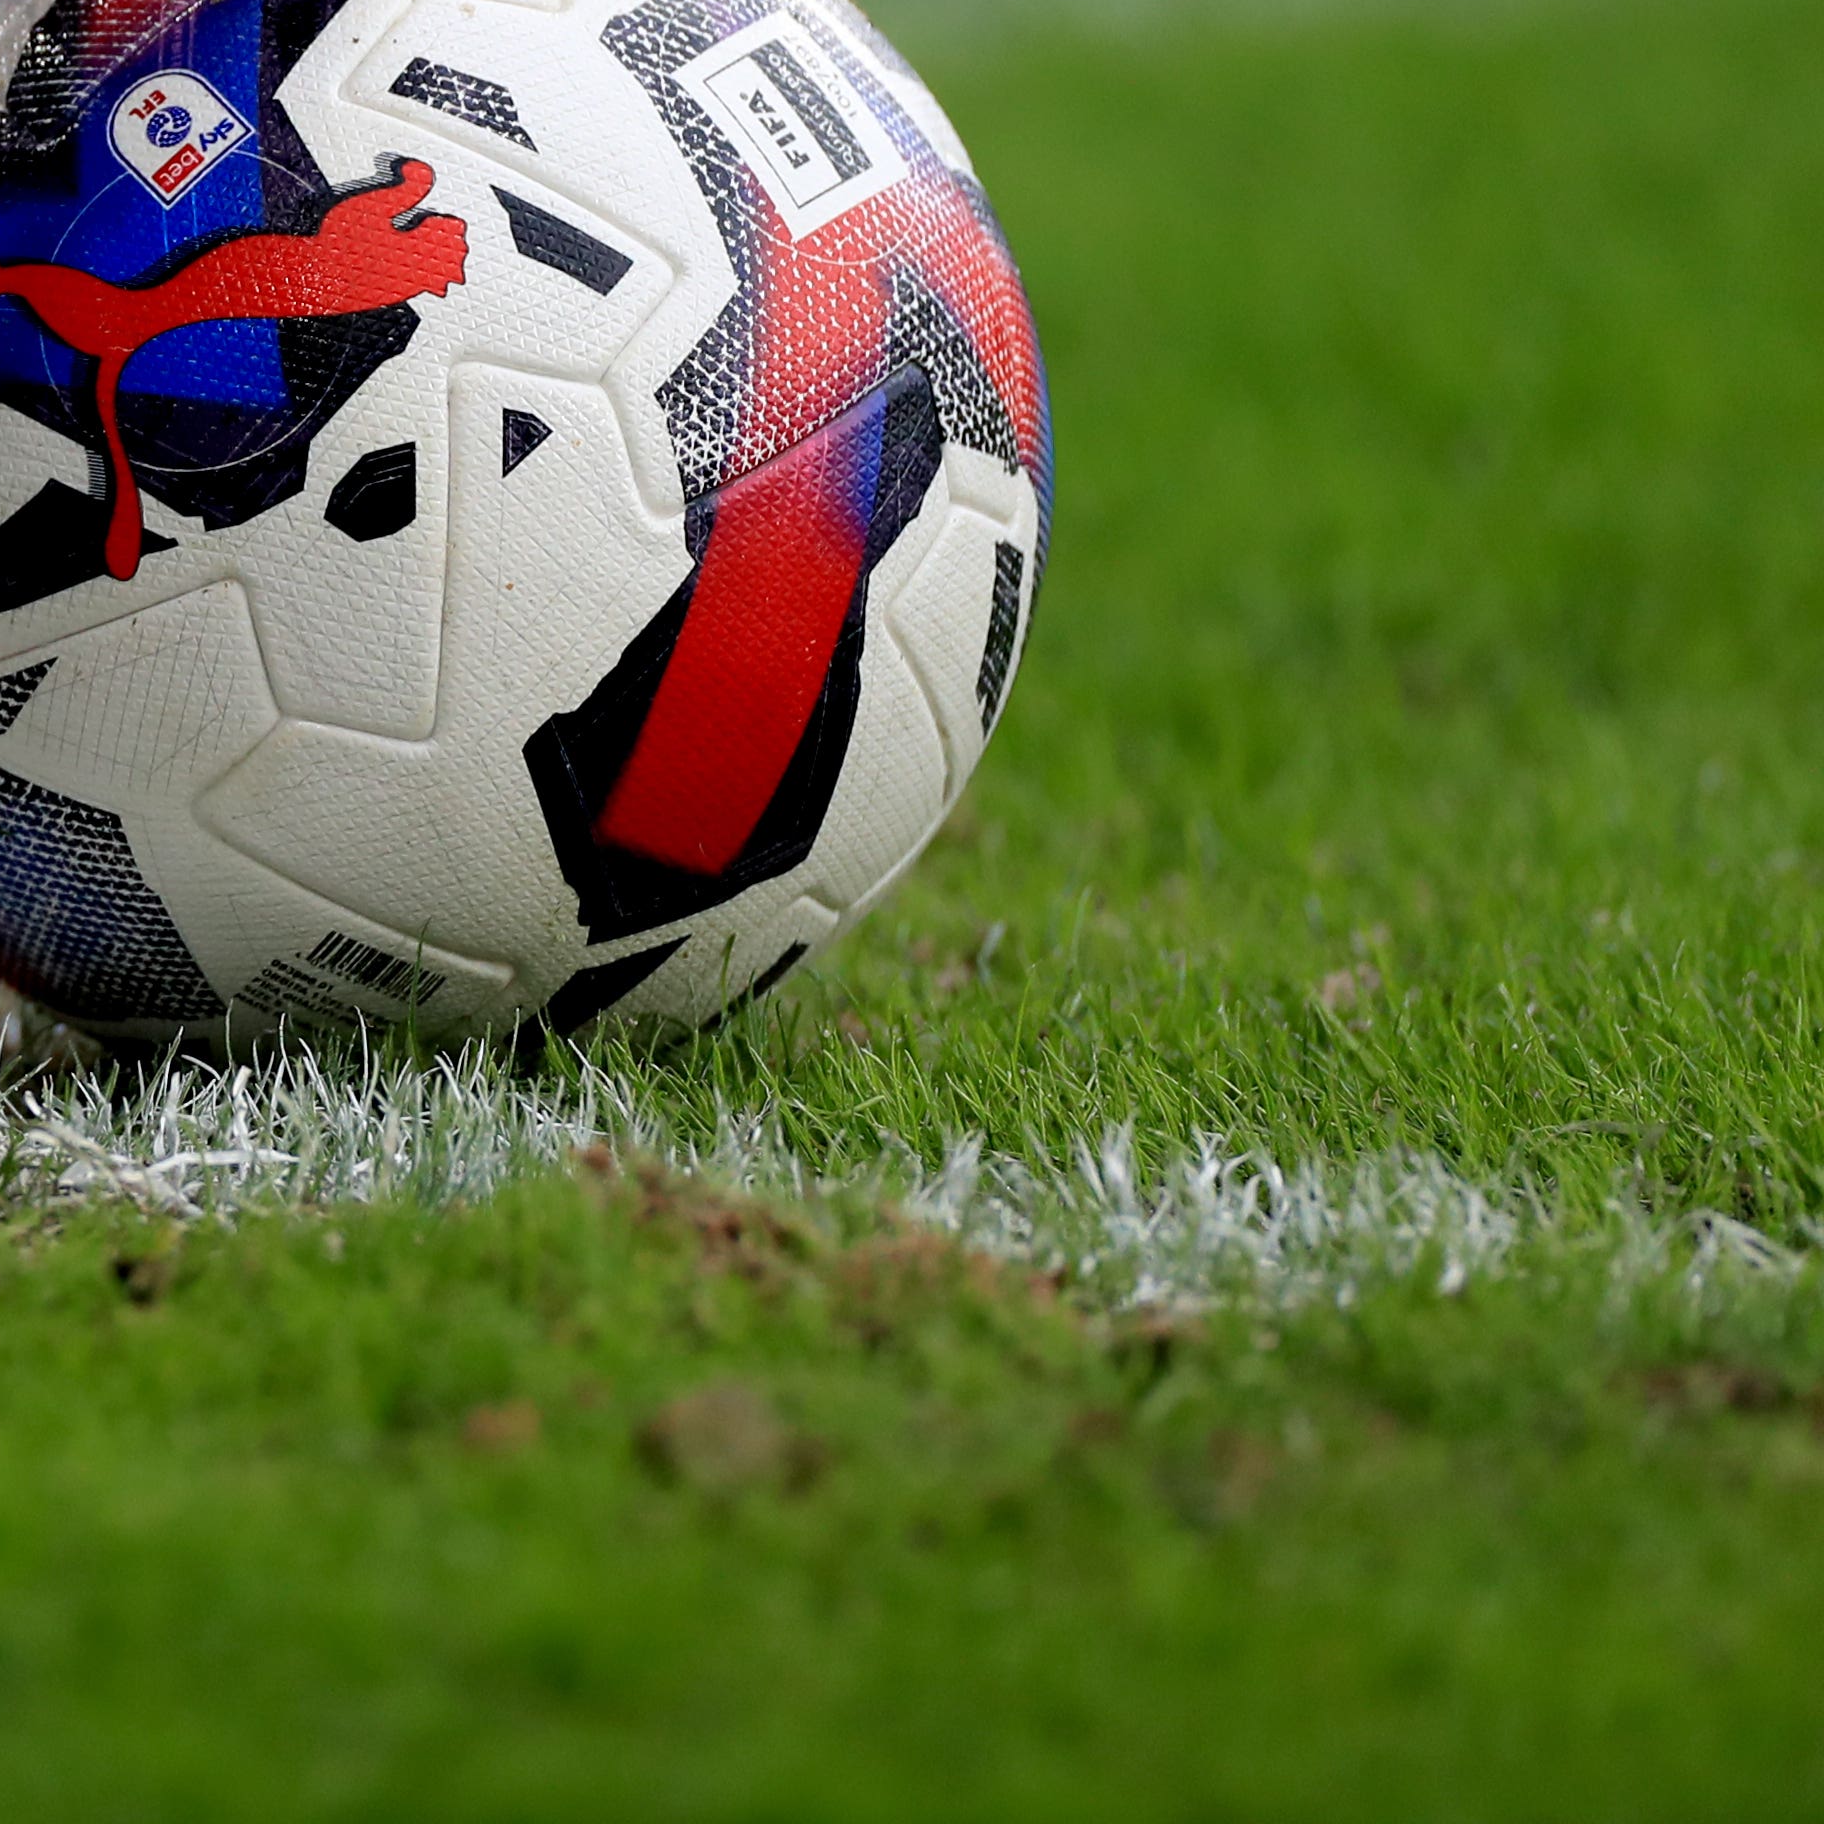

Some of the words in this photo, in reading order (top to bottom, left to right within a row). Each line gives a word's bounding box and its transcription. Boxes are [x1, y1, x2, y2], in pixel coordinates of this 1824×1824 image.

[768, 52, 799, 89] PRO
[128, 89, 167, 121] EFL
[198, 117, 235, 153] sky
[799, 92, 856, 166] QUALITY
[158, 149, 200, 187] bet
